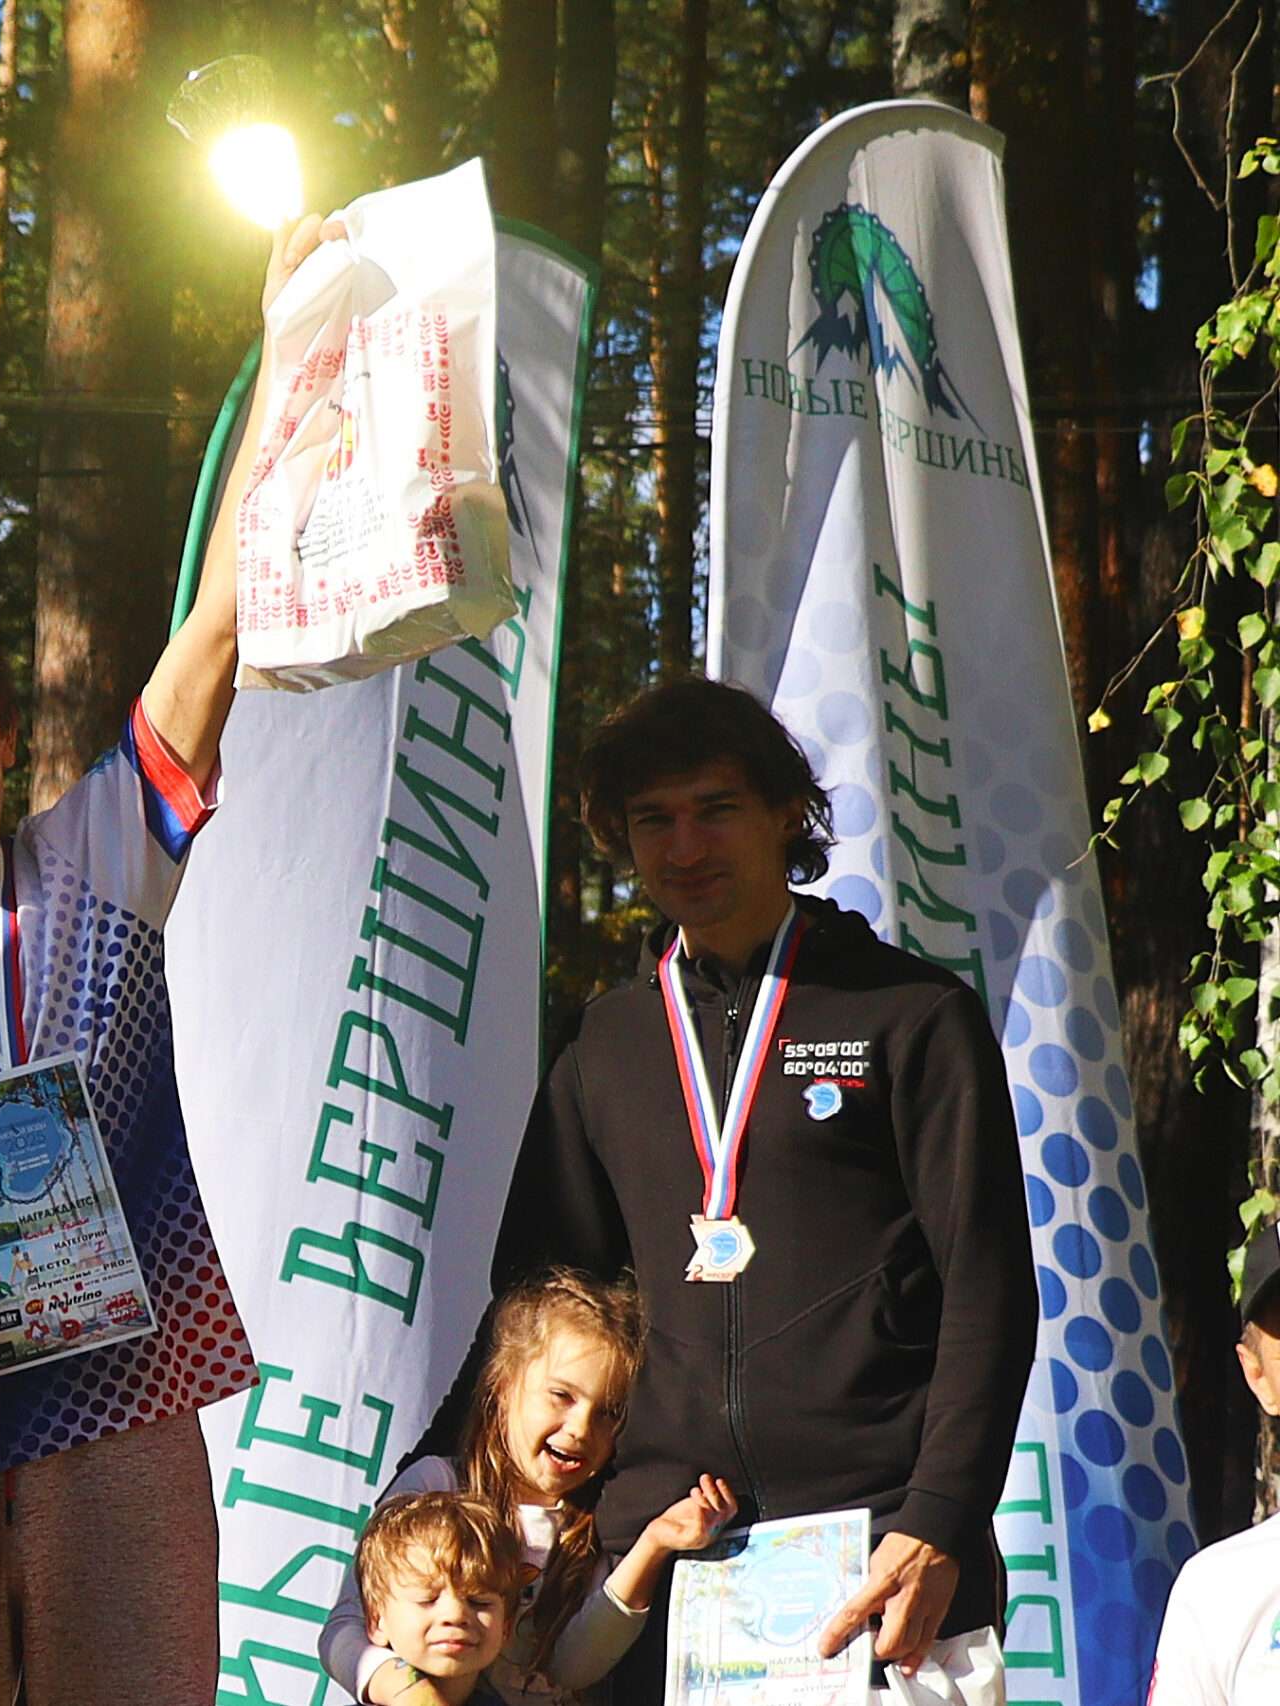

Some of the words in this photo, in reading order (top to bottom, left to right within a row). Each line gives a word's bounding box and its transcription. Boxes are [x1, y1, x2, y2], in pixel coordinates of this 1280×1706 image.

[741, 358, 868, 419] НОВЫЕ
[877, 404, 1032, 491] ЕРШИН
[18, 1193, 99, 1224] НАГРАЖДАЕТС
[27, 1258, 71, 1275] МЕСТО
[692, 1264, 704, 1281] 2
[48, 1290, 103, 1312] Neutrino
